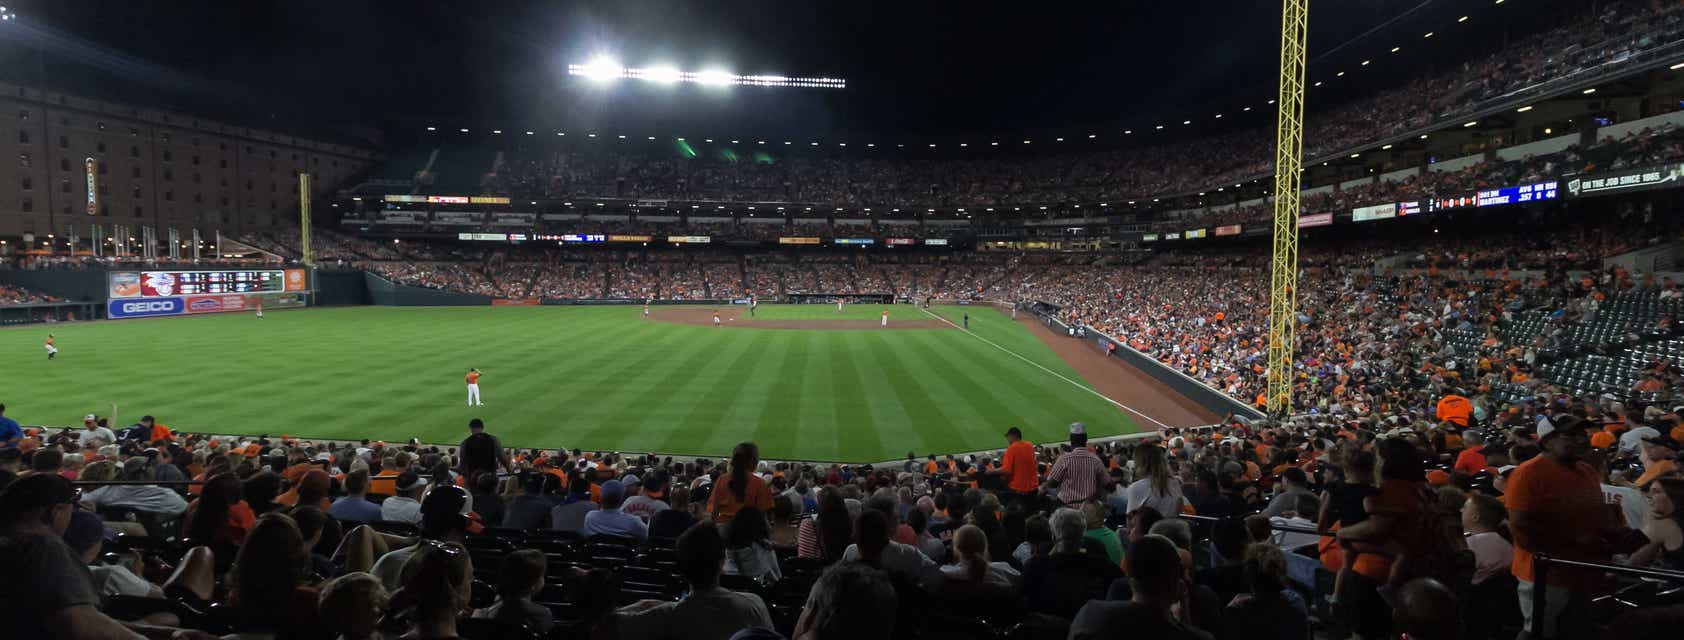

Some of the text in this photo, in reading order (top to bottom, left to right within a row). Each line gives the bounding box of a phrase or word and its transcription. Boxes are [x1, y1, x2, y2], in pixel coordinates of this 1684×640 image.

[1546, 182, 1556, 190] RBI
[1582, 181, 1591, 189] ON
[1592, 179, 1605, 188] THE
[1605, 178, 1619, 186] JOB
[1620, 174, 1641, 185] SINCE
[1480, 196, 1509, 206] MARTINEZ
[123, 301, 174, 313] GEICO
